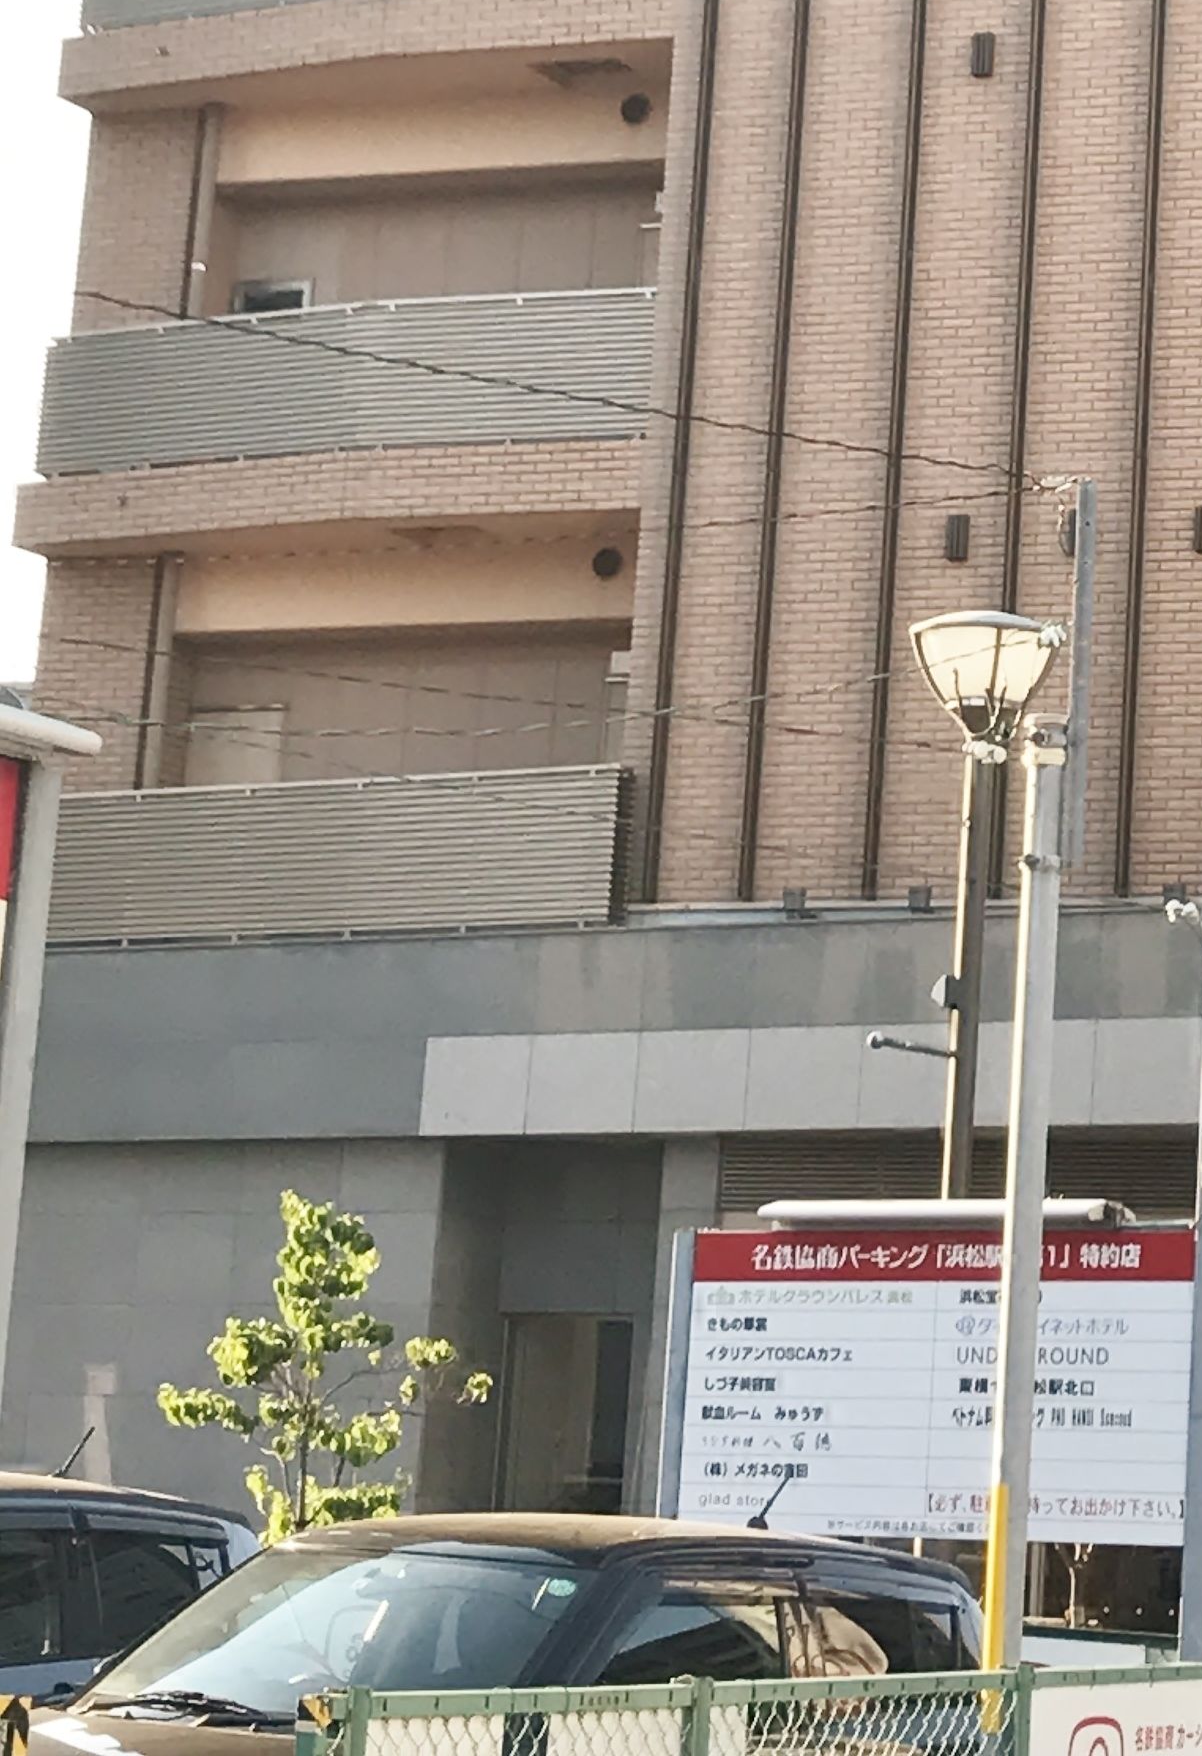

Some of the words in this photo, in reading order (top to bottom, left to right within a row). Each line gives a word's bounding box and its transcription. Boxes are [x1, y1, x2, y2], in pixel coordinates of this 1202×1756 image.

[1080, 1243, 1141, 1269] 特約店
[705, 1346, 853, 1362] イタリアンTOSCAカフェ
